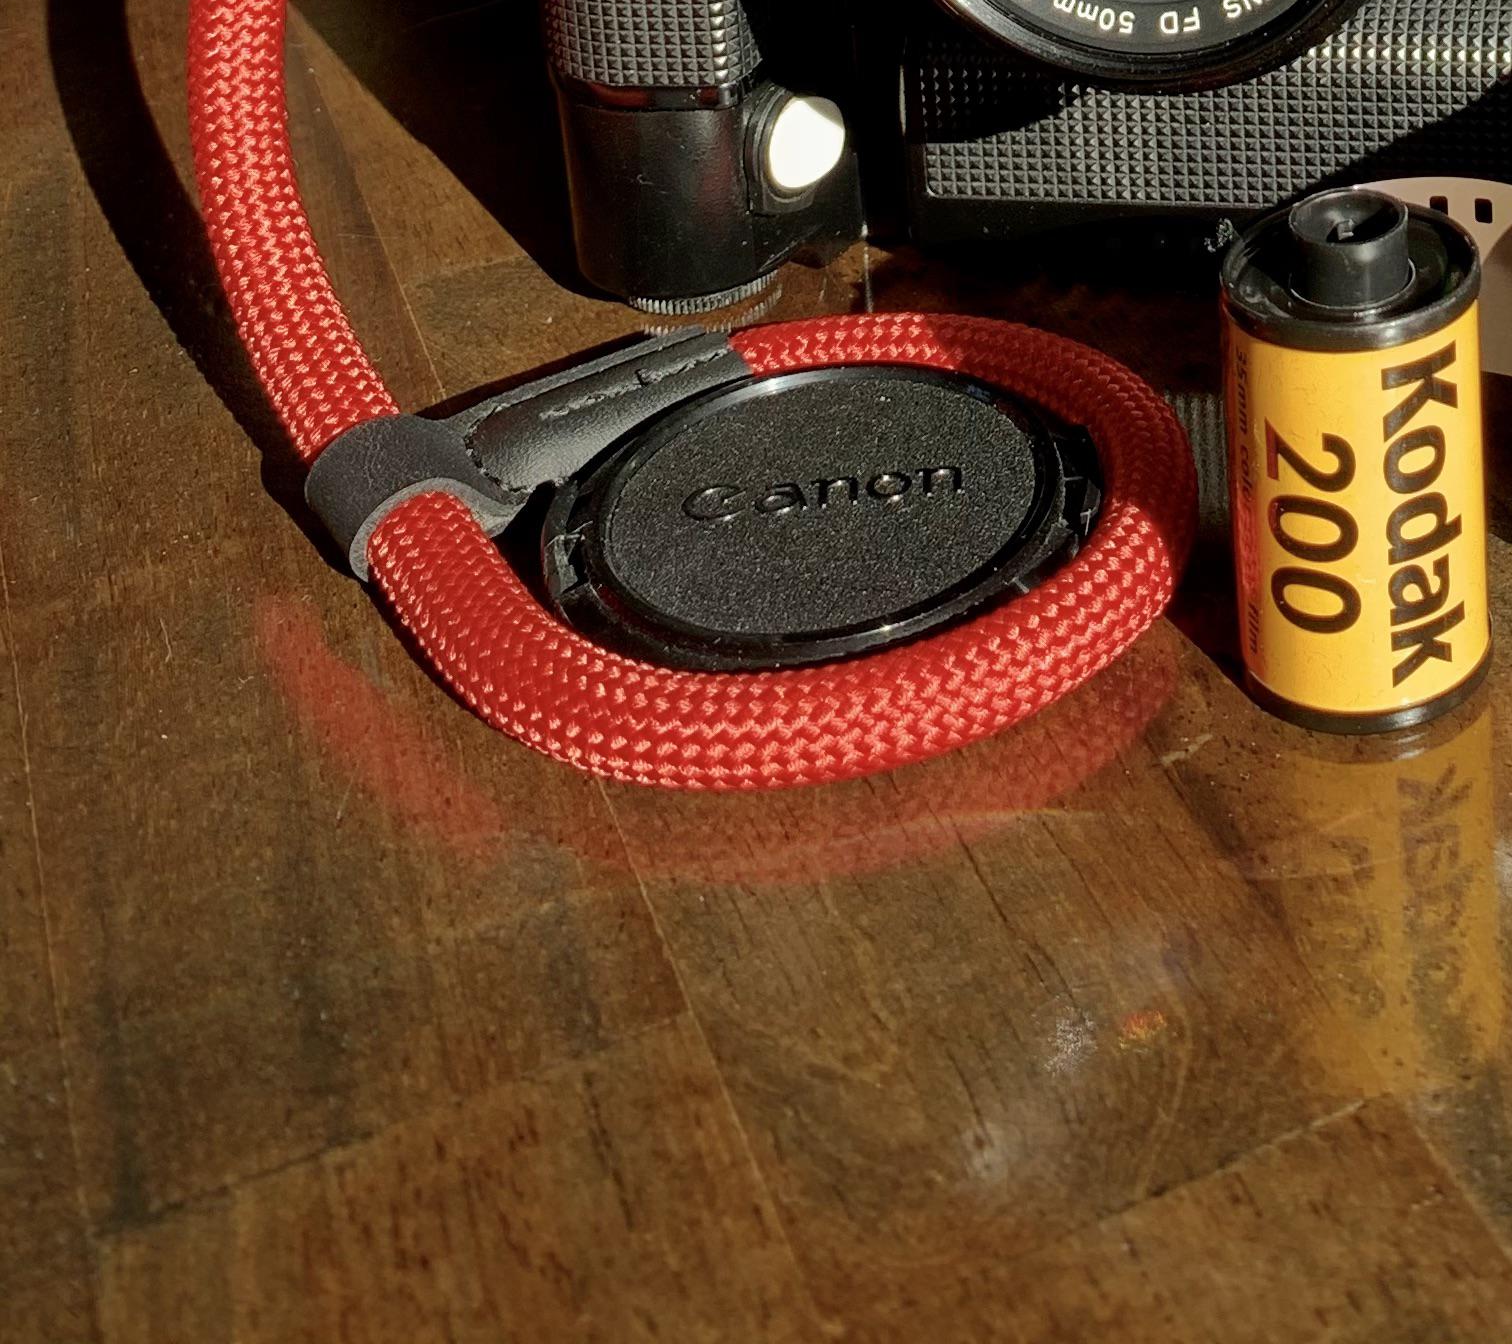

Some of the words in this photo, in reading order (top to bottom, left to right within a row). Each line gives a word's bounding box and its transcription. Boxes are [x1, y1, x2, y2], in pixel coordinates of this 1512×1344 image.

[1159, 6, 1201, 34] FD
[680, 462, 966, 523] Canon
[1264, 417, 1362, 635] 200
[1380, 340, 1465, 689] Kodak
